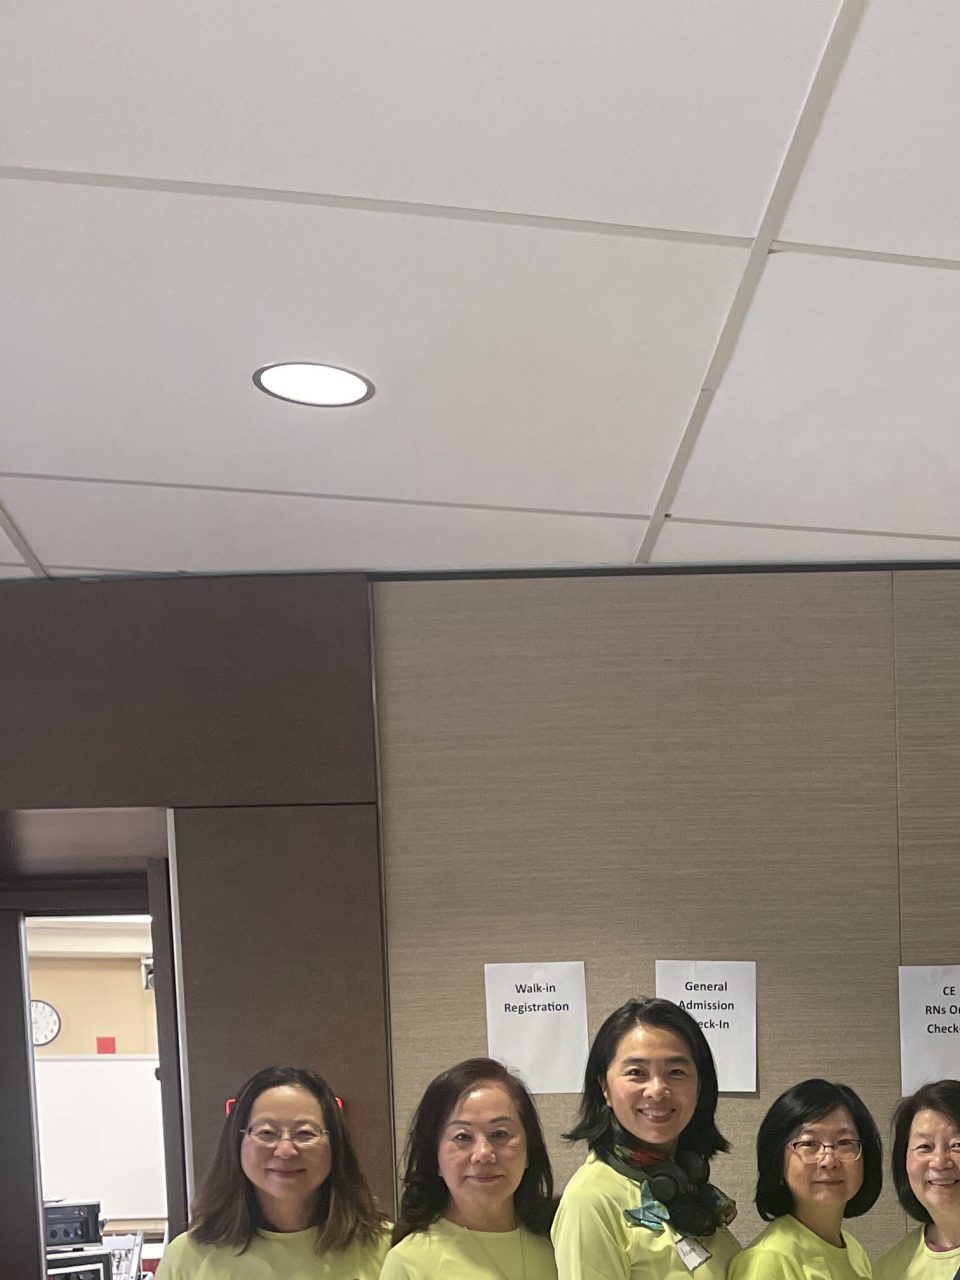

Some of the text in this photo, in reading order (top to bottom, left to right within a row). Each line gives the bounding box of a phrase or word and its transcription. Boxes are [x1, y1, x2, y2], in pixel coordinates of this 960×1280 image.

[514, 983, 556, 995] Walk-in
[684, 981, 728, 993] General
[942, 986, 957, 997] CE
[504, 1001, 570, 1014] Registration
[678, 1000, 735, 1012] Admission
[924, 1004, 947, 1016] RNs
[698, 1019, 730, 1030] eck-In
